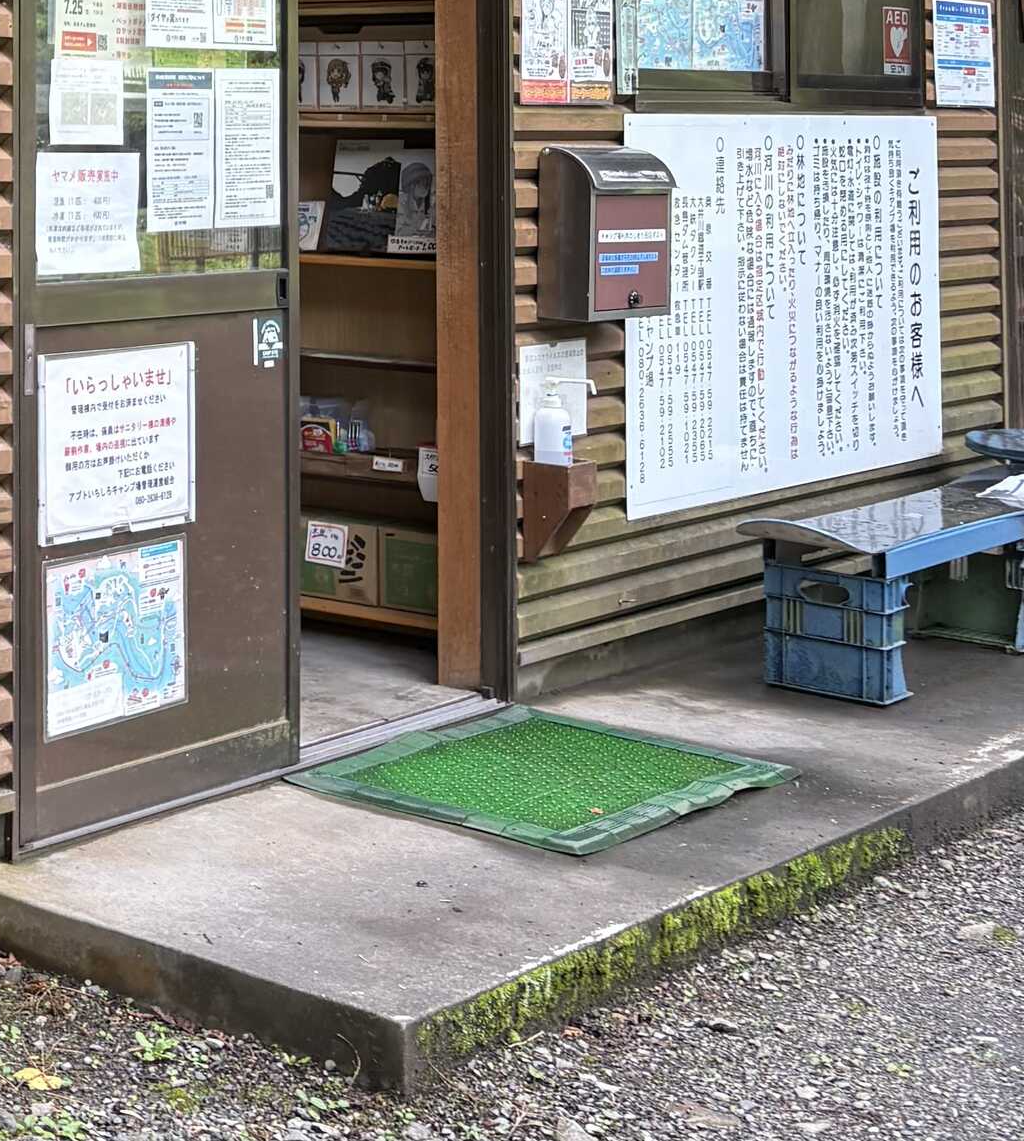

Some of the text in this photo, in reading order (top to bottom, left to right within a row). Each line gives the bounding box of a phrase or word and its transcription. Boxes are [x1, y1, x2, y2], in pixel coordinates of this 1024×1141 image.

[886, 10, 909, 26] AED
[907, 166, 924, 408] ご利用のお客様へ
